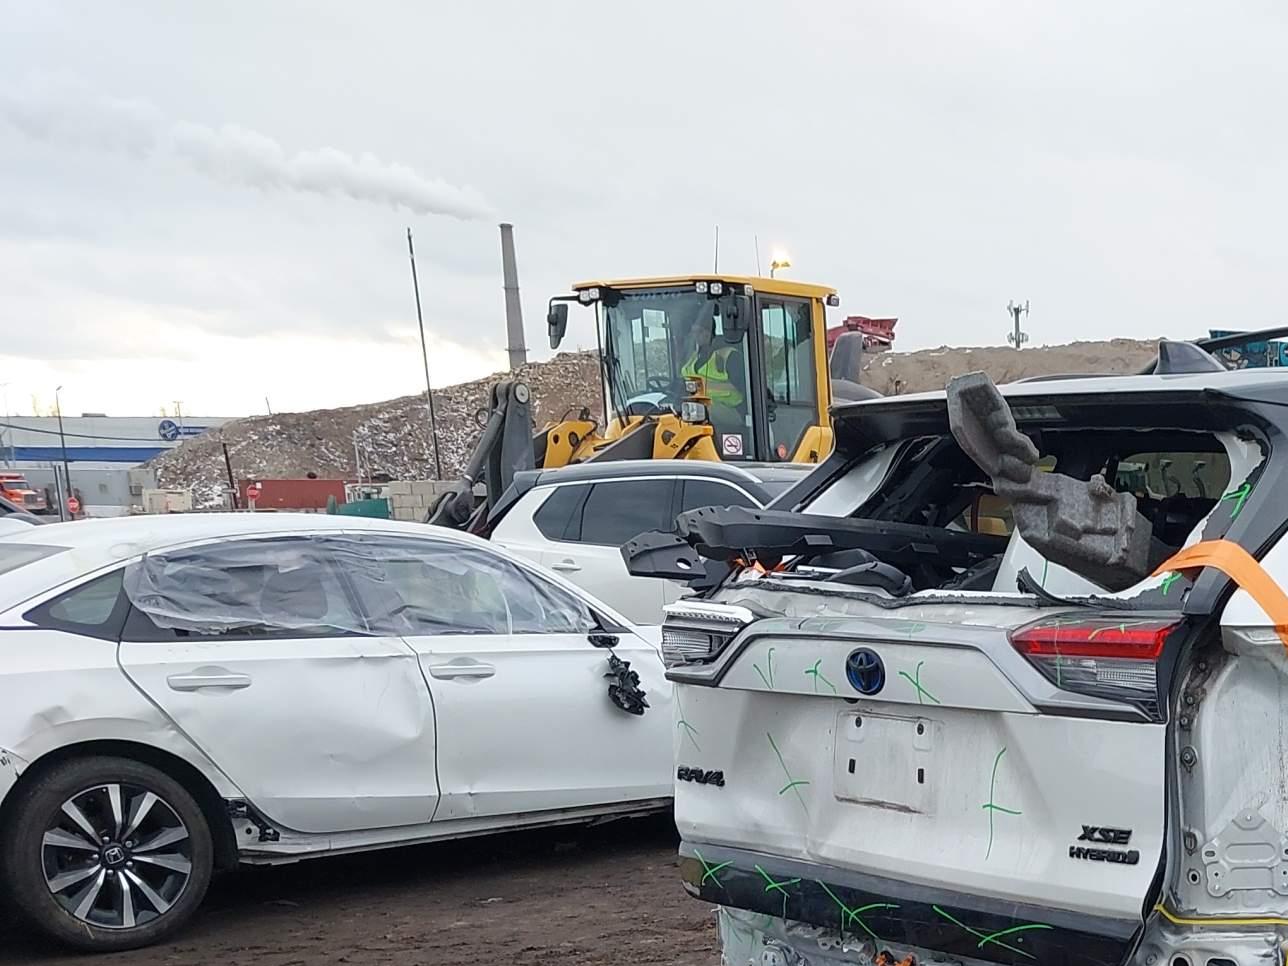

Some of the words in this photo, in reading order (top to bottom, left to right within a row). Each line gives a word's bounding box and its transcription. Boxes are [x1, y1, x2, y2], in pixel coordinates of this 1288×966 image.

[678, 766, 725, 787] RAV4
[1077, 825, 1132, 845] XSE
[1069, 846, 1132, 865] HYBRID
